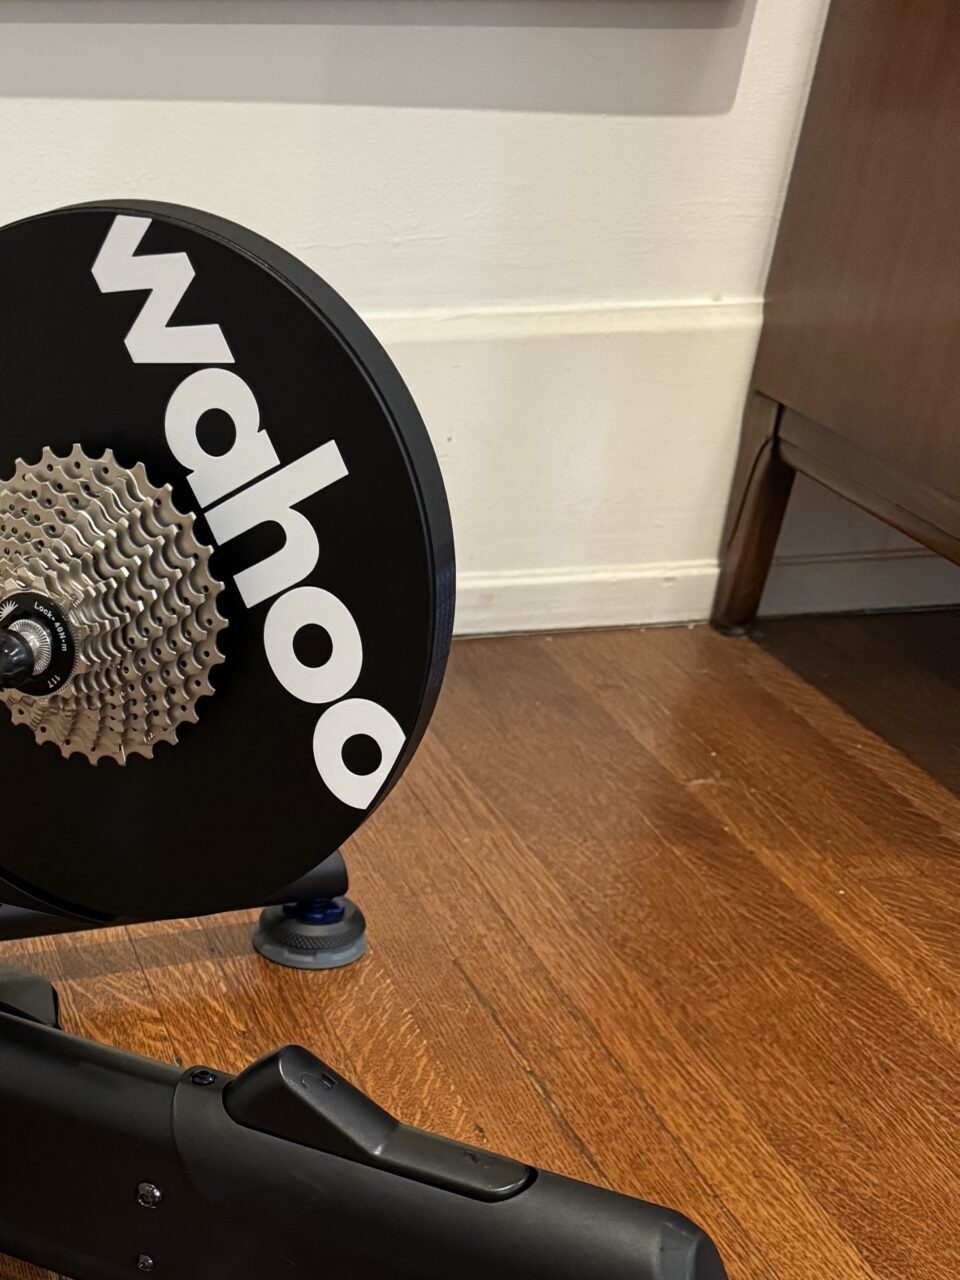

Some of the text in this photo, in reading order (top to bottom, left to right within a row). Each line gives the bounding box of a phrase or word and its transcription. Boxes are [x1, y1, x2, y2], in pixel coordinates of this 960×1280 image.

[91, 214, 406, 810] wahoo
[34, 601, 53, 619] Lock
[47, 675, 61, 689] 11T
